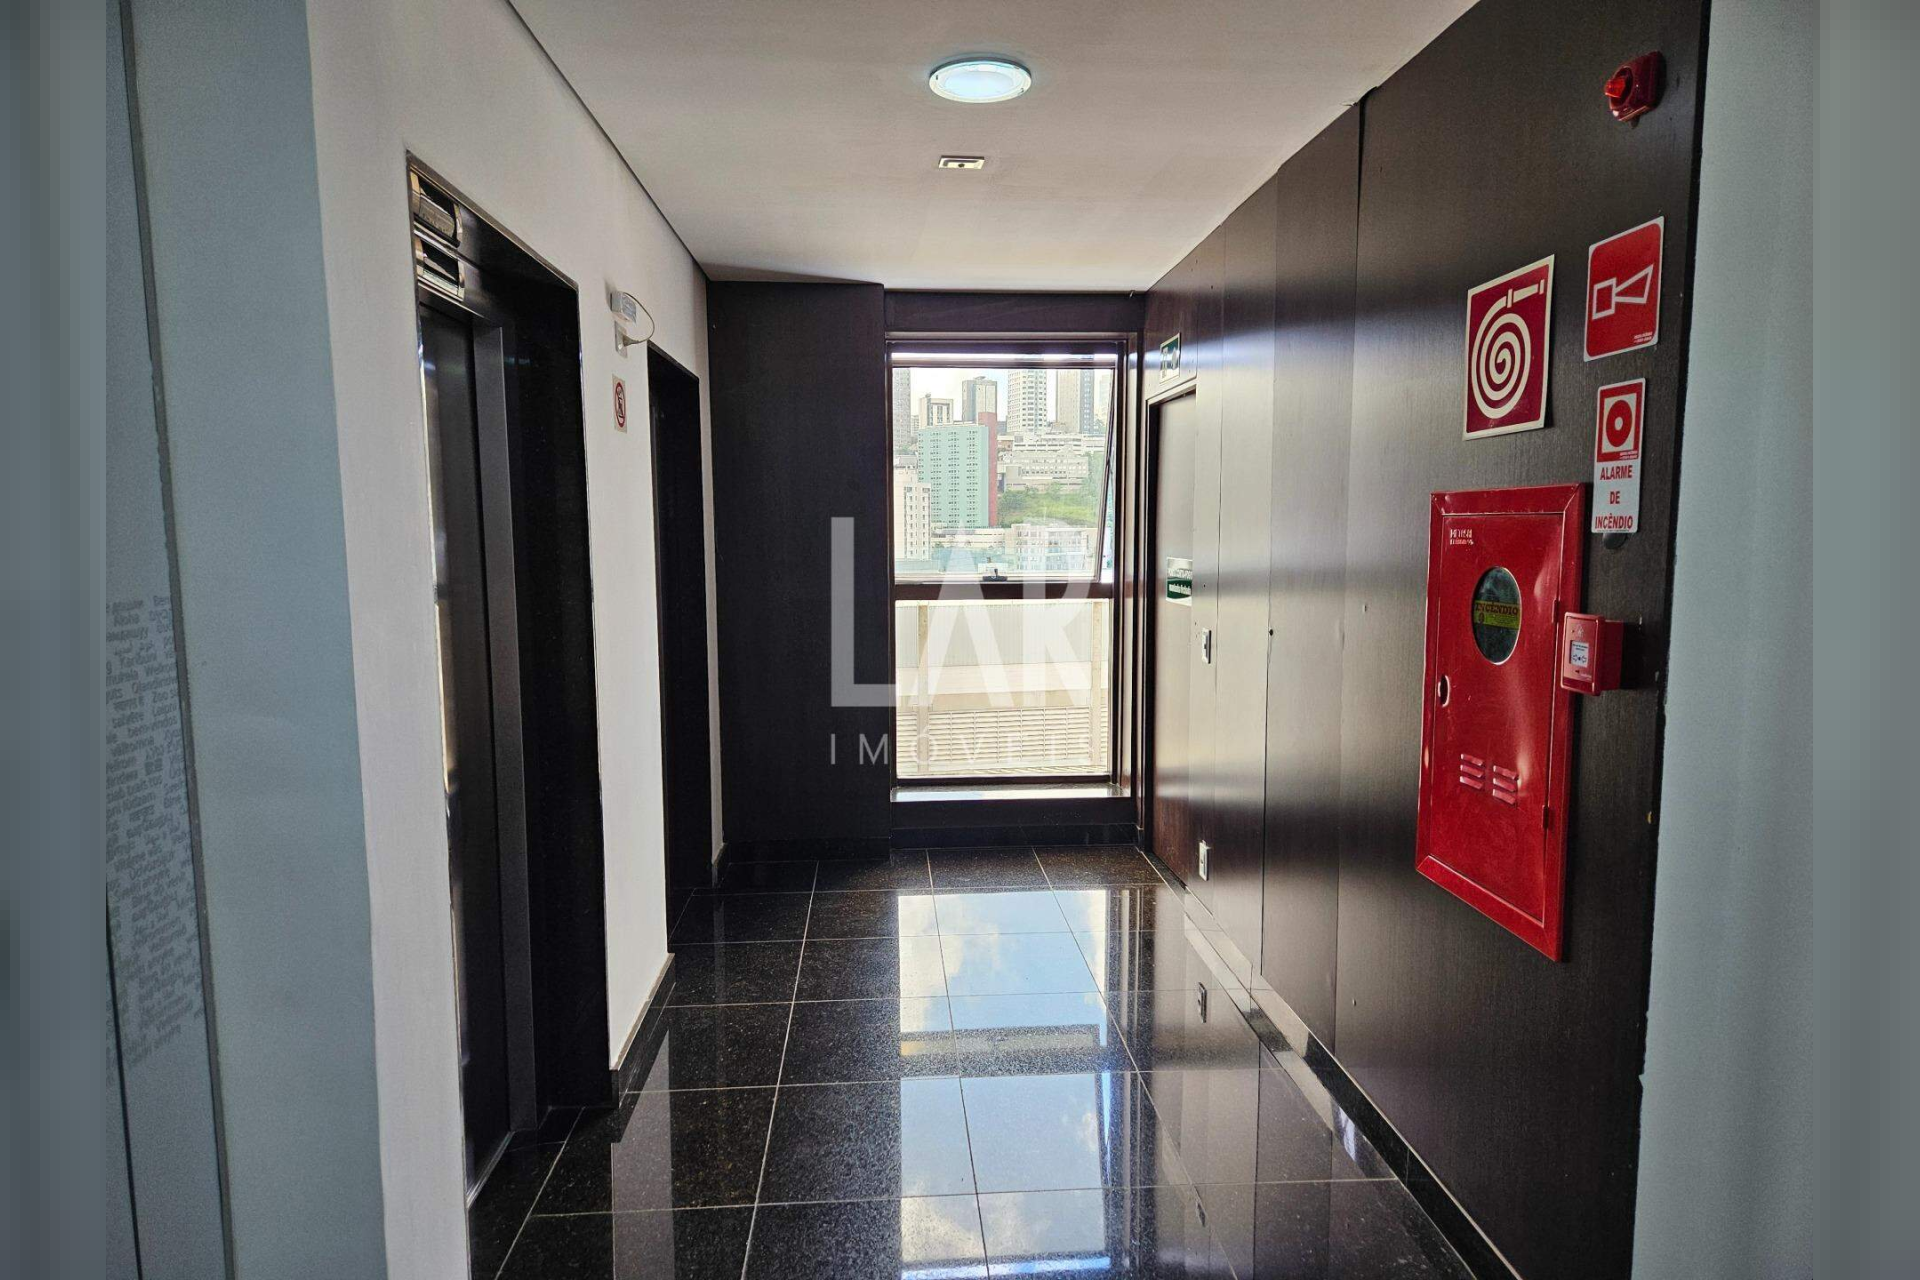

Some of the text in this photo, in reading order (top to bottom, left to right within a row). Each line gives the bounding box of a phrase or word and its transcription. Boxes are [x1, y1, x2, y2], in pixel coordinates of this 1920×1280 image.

[1600, 464, 1633, 481] ALARME
[1609, 490, 1621, 505] DE
[1595, 512, 1634, 530] INCÊNDIO
